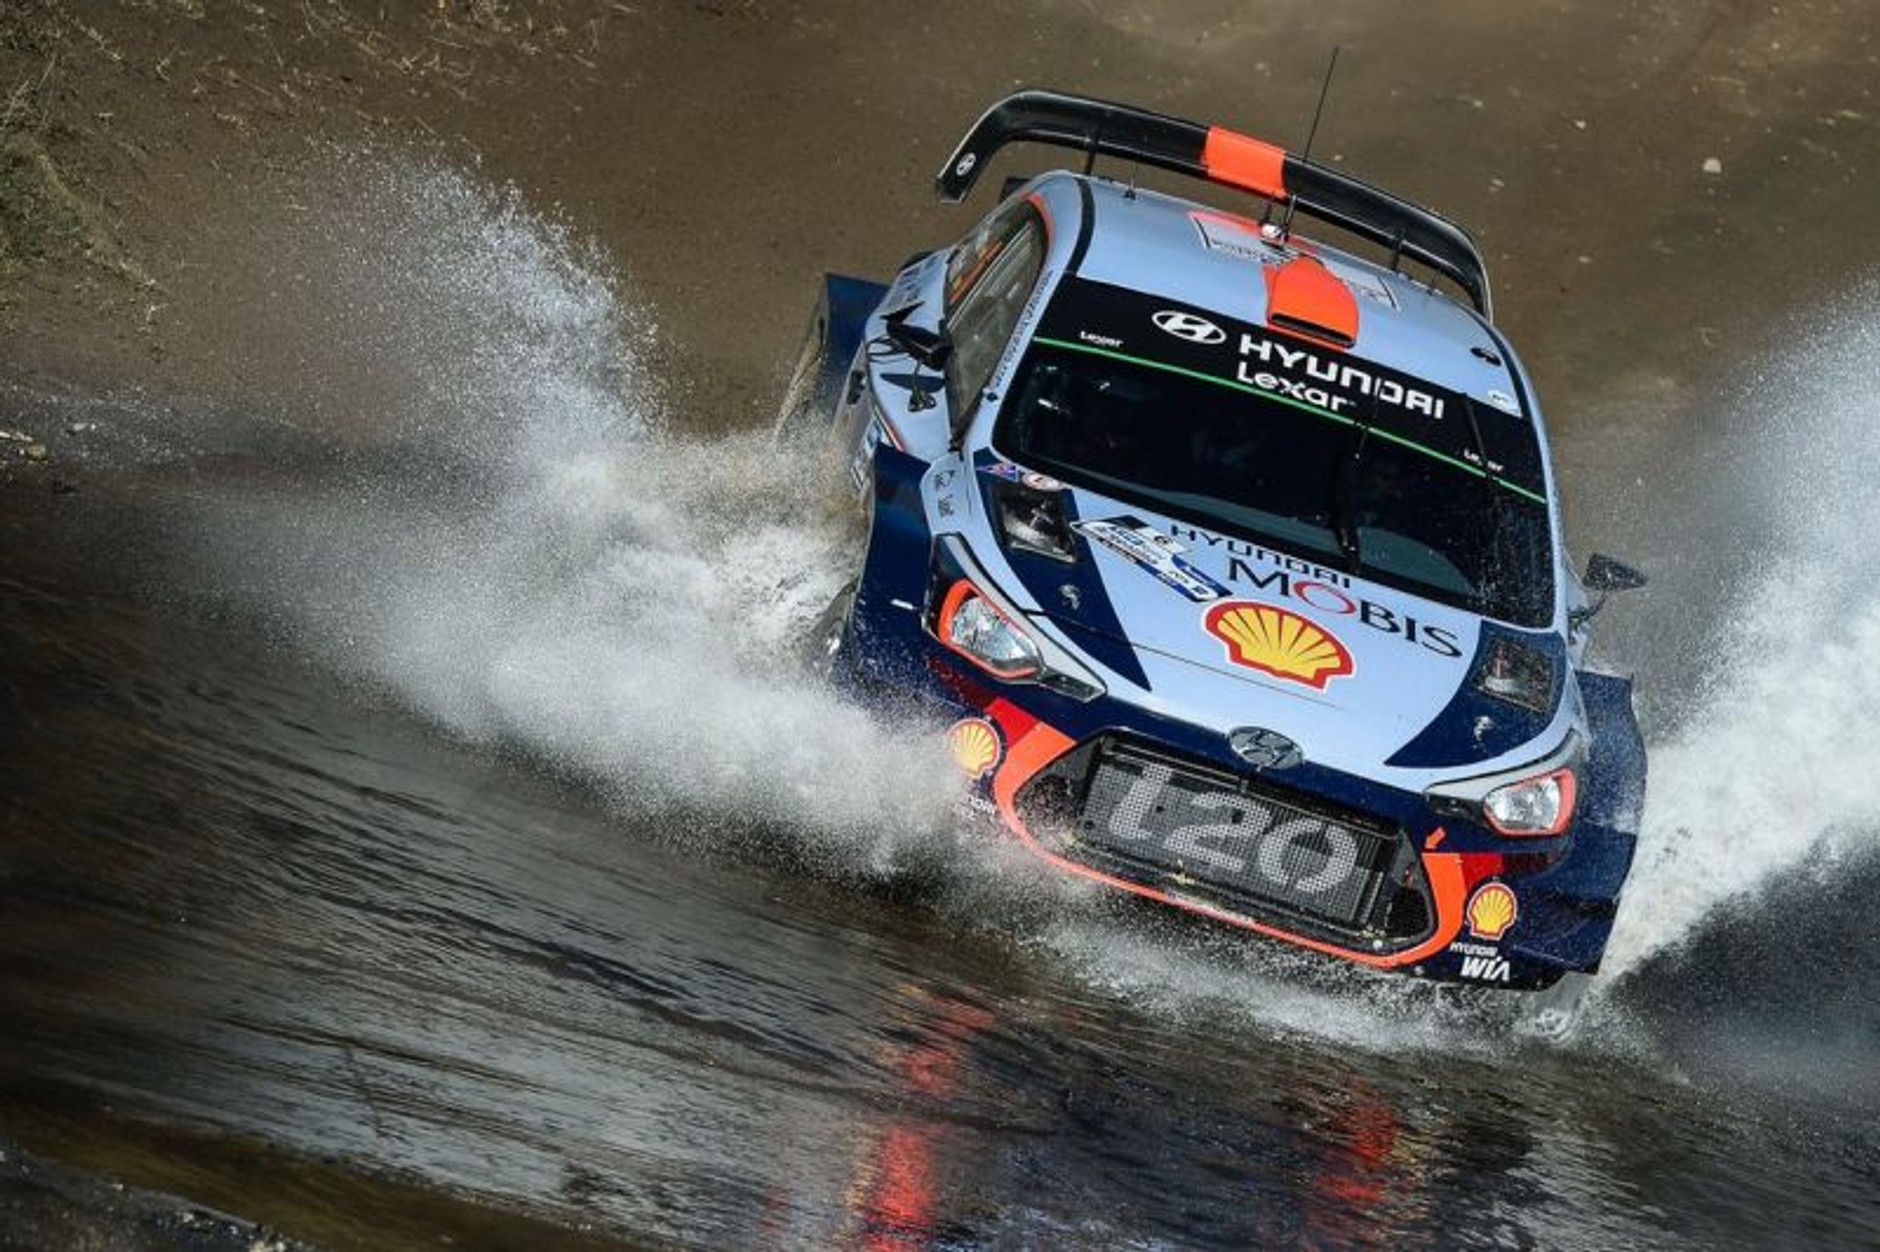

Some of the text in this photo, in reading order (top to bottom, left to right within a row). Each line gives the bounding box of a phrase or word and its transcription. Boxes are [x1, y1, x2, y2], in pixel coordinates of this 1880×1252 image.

[1236, 360, 1350, 413] Lexar
[1239, 333, 1445, 420] HYUNDAI
[1463, 447, 1504, 472] Lear
[1170, 524, 1352, 589] HYUNDAI
[1227, 557, 1464, 659] MOBIS
[1460, 954, 1511, 982] WIA
